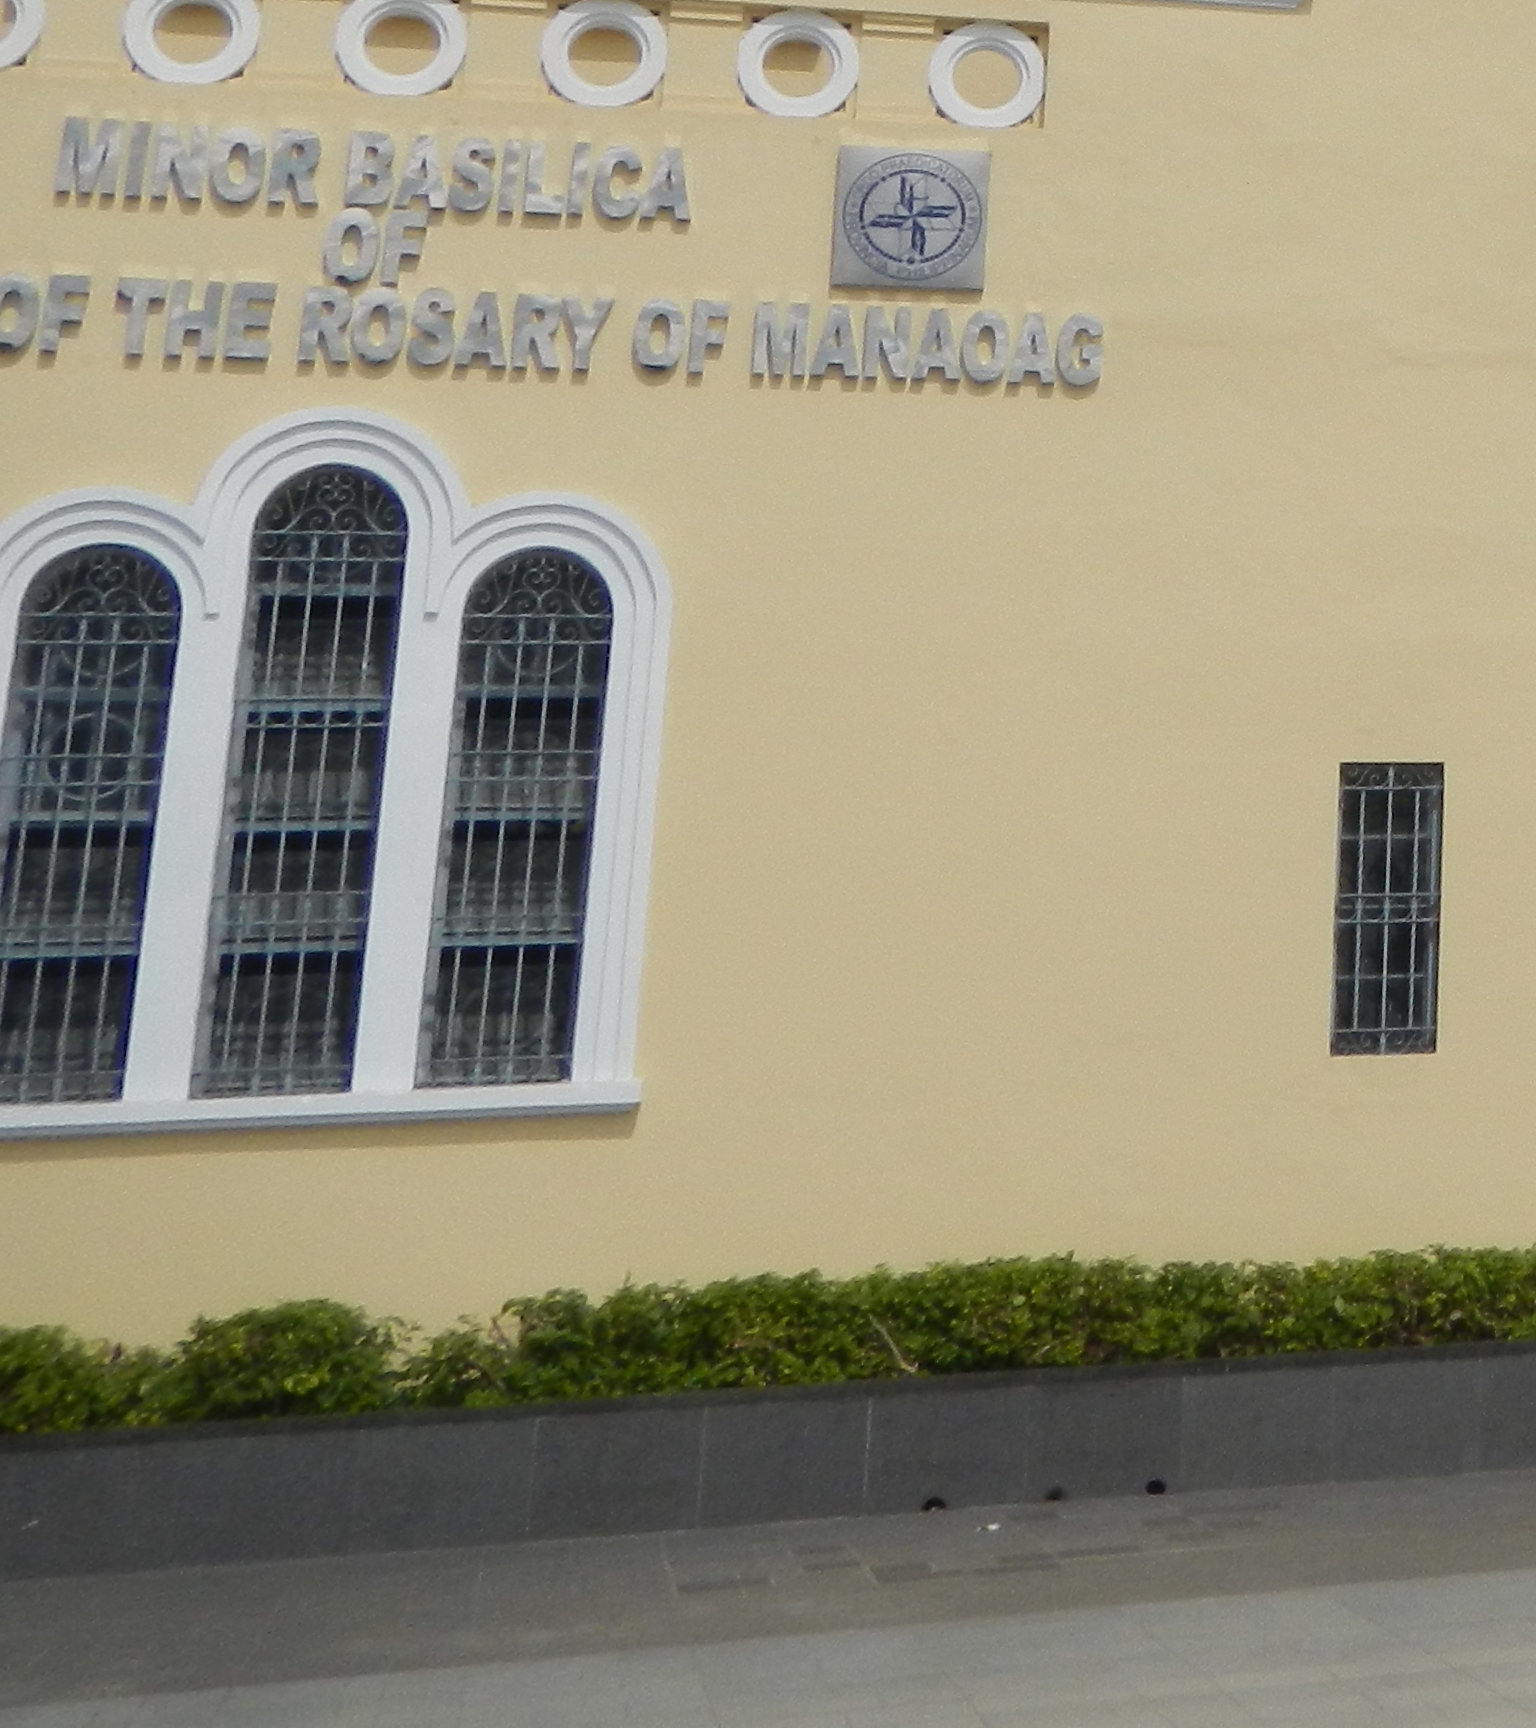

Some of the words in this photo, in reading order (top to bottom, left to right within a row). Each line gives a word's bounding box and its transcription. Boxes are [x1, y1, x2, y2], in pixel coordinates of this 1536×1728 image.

[53, 115, 322, 207] MINOR
[344, 129, 692, 223] BASILICA
[323, 206, 430, 287] OF
[0, 274, 91, 355] OF
[117, 275, 279, 362] THE
[298, 285, 615, 372] ROSARY
[631, 297, 731, 374] OF
[749, 301, 1105, 387] MANAOAG
